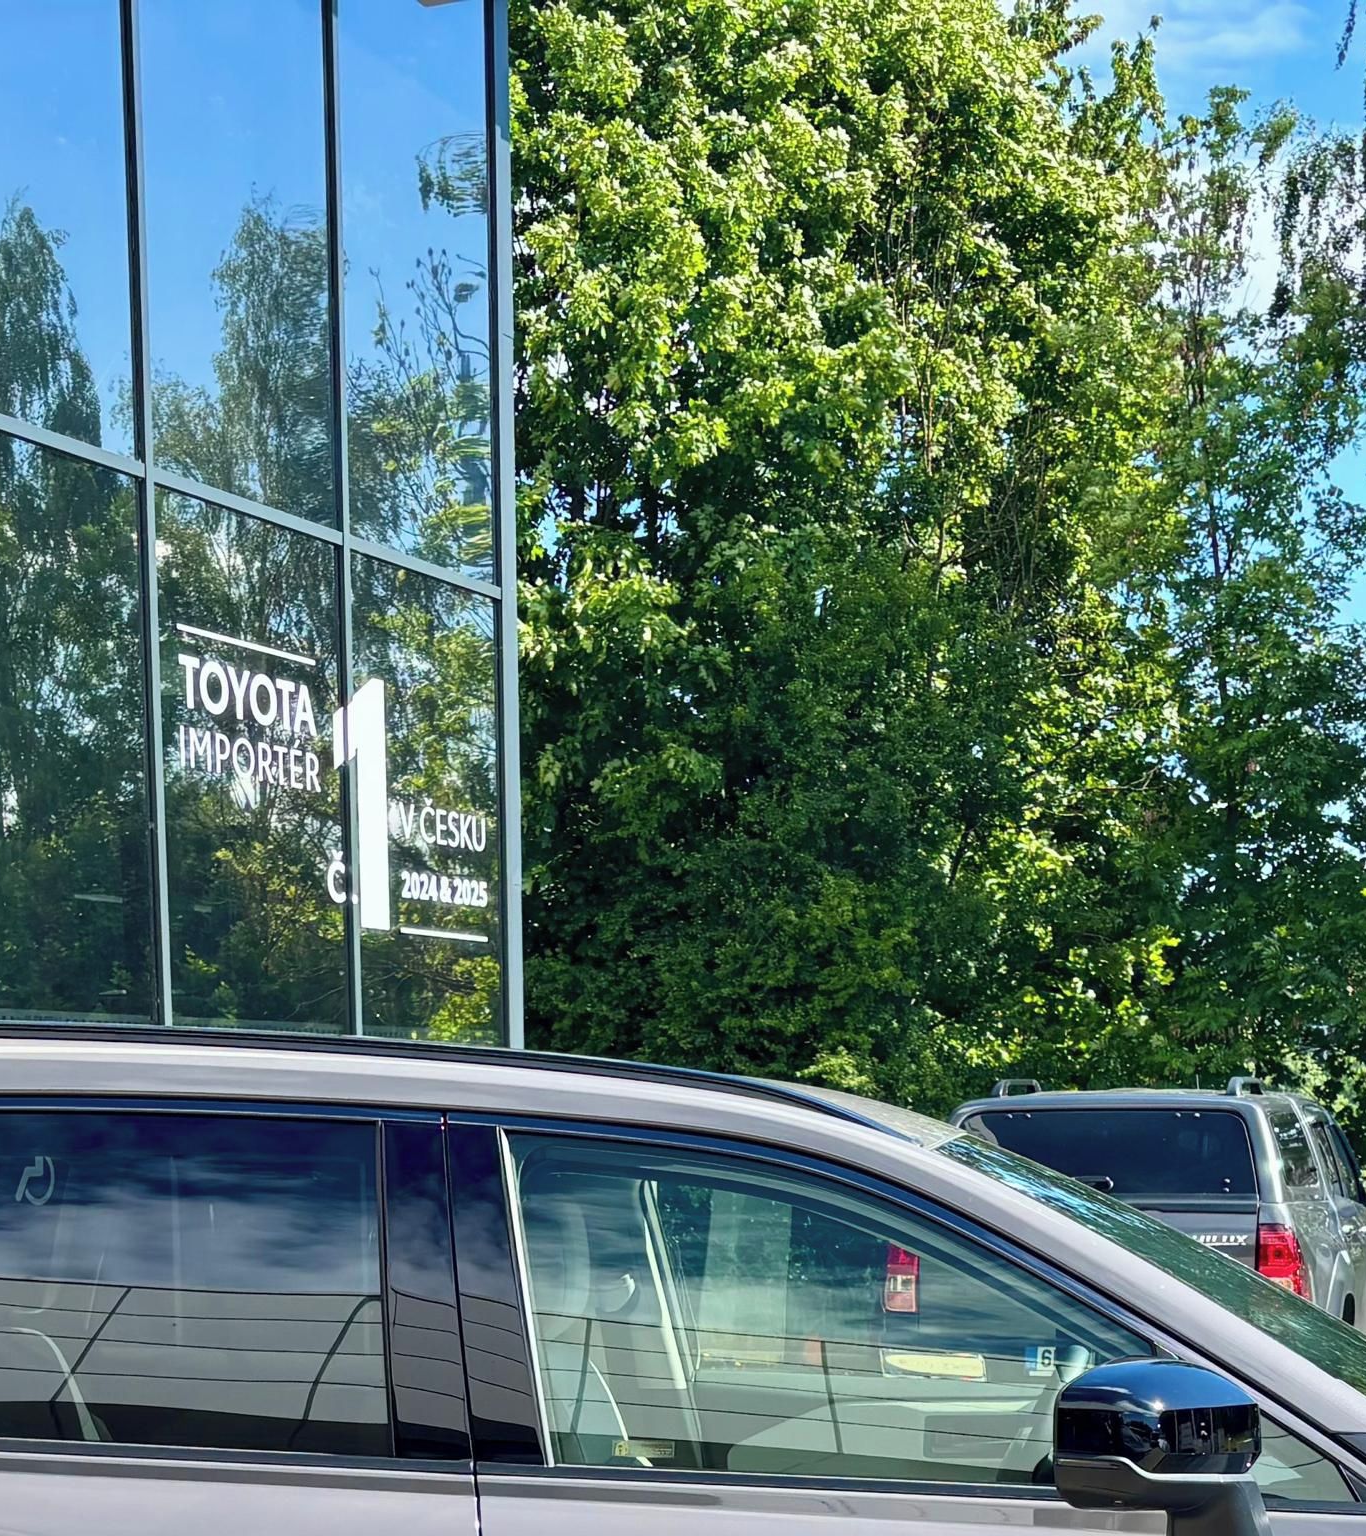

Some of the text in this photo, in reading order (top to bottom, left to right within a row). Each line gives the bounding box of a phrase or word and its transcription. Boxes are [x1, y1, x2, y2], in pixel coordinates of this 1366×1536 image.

[177, 653, 317, 737] TOYOTA
[179, 724, 322, 793] IMPORTÉR
[333, 677, 390, 930] 1
[398, 801, 415, 840] V
[419, 797, 487, 852] ČESKU
[401, 870, 488, 908] 2024 & 2025
